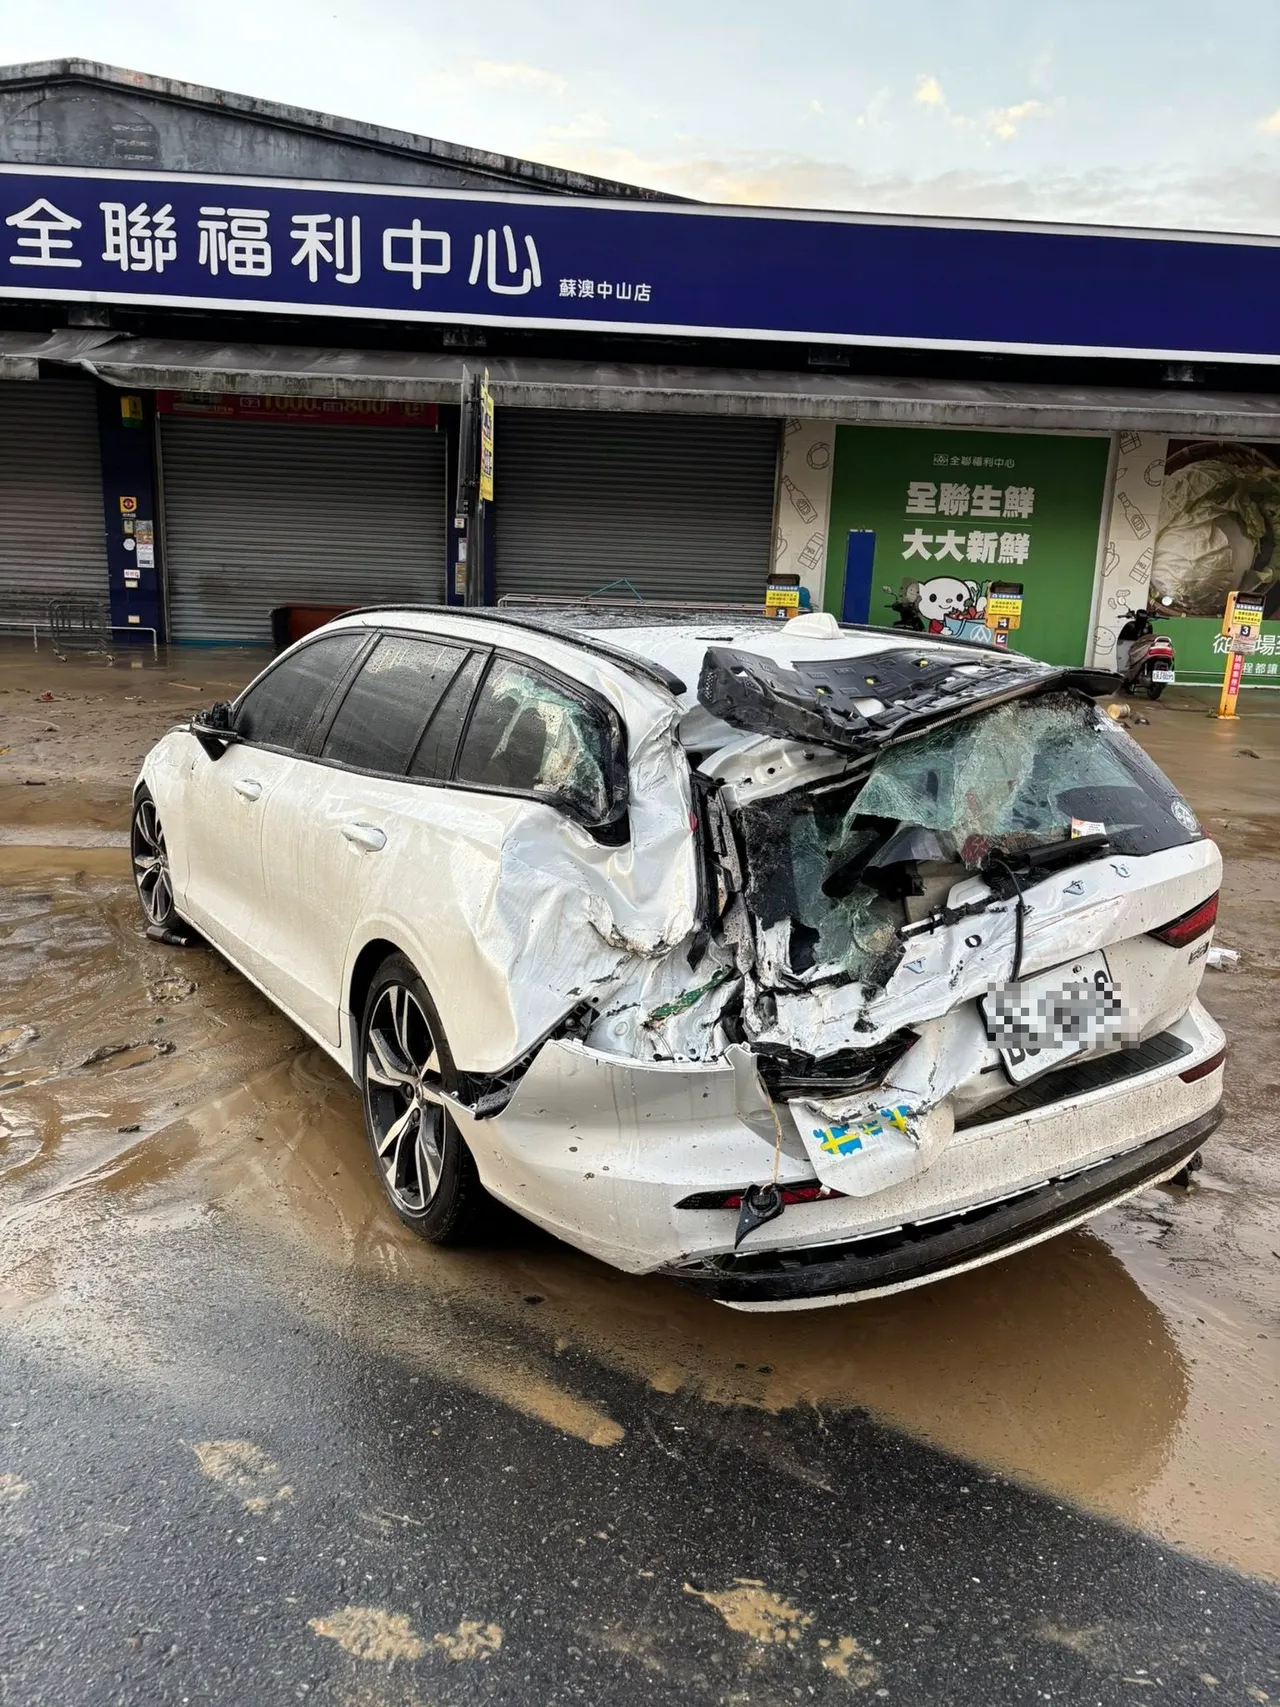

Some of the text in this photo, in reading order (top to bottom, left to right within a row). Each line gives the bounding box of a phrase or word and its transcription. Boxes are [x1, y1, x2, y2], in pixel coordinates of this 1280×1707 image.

[5, 198, 542, 296] 全聯福利中心
[559, 278, 652, 302] 蘇澳中山店
[950, 455, 1016, 469] 全聯福利中心
[905, 481, 1035, 519] 全聯生鮮
[901, 528, 1031, 565] 大大新鮮
[778, 609, 785, 618] 5
[1242, 626, 1249, 635] 3
[1243, 662, 1278, 675] 程都讓
